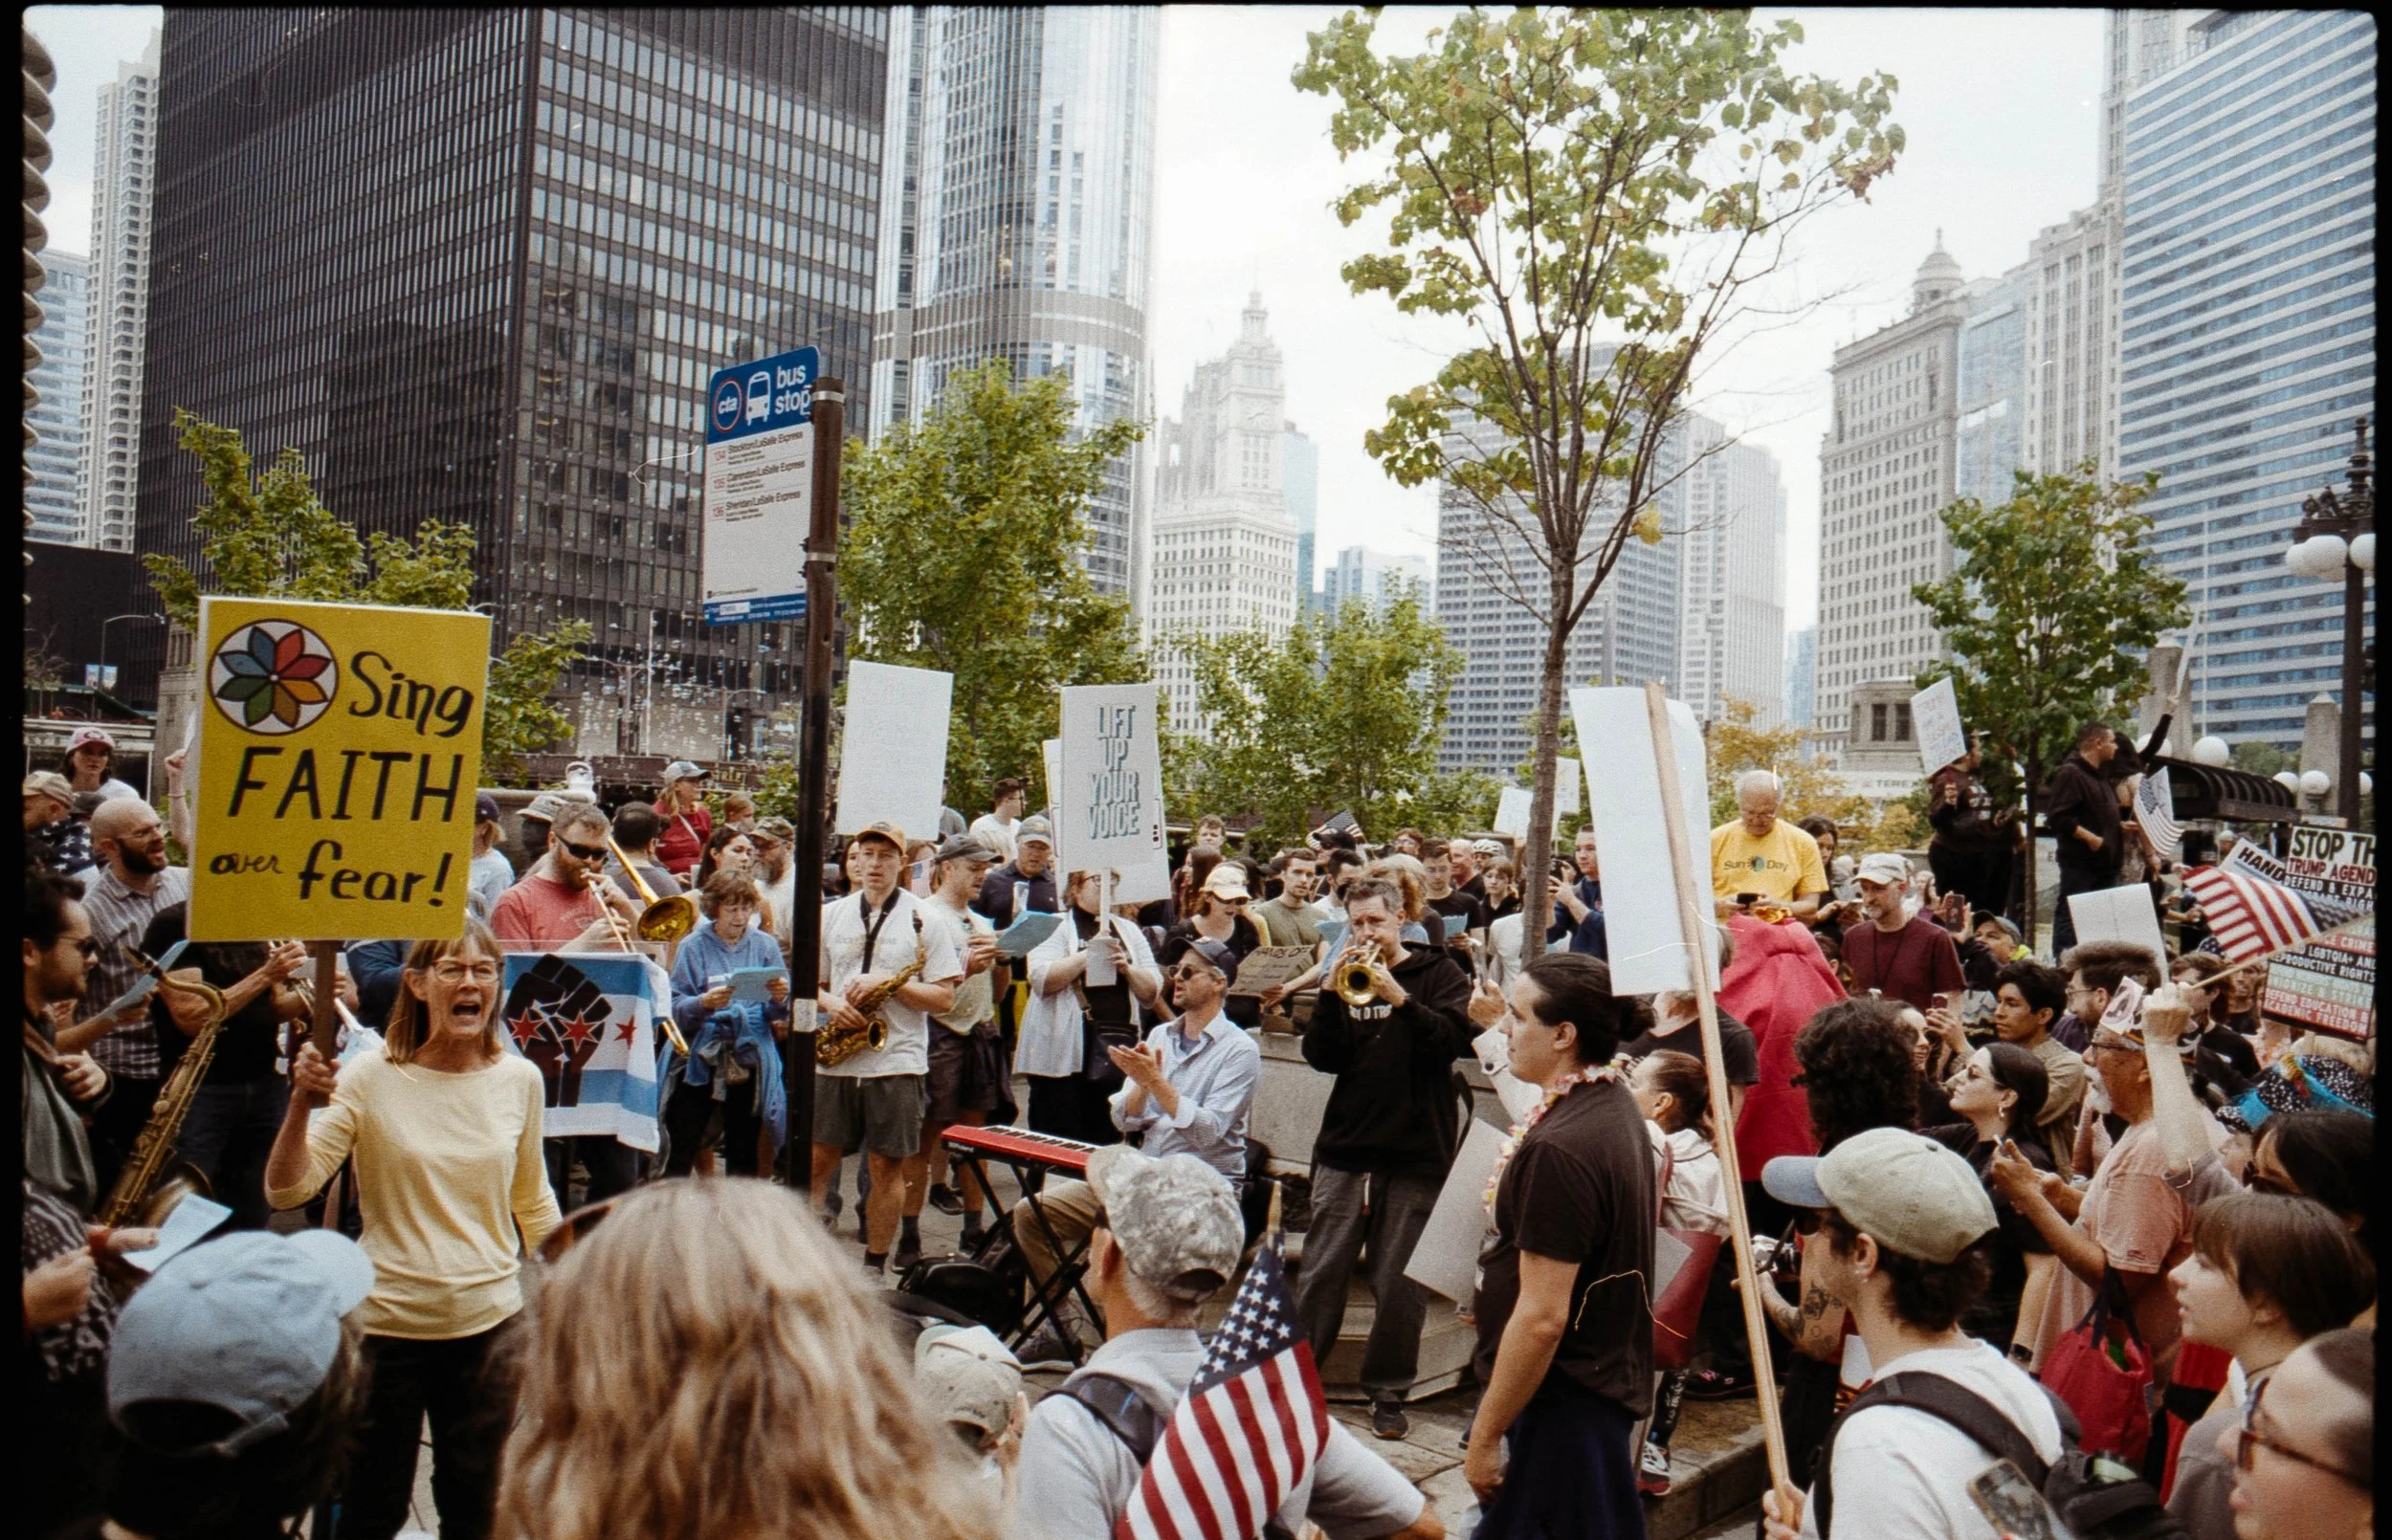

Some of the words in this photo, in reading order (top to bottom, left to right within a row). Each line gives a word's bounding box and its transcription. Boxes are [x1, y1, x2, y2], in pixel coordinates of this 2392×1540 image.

[776, 364, 807, 388] bus
[718, 396, 738, 414] cta
[774, 388, 811, 415] stop
[778, 431, 804, 444] Express
[780, 460, 806, 473] Express
[775, 491, 801, 502] Express
[347, 650, 475, 738] Sing
[1093, 703, 1137, 739] LIFT
[1099, 737, 1129, 771] UP
[228, 746, 464, 822] FAITH
[1089, 769, 1141, 806] YOUR
[1088, 802, 1141, 840] VOICE
[2292, 828, 2344, 861] STOP
[210, 852, 285, 875] over
[298, 839, 454, 908] fear!
[1723, 860, 1746, 870] Sun
[1766, 860, 1788, 872] Day
[2238, 847, 2286, 882] HAND
[2289, 857, 2327, 877] TRUMP
[2330, 864, 2377, 885] AGEND
[2285, 876, 2323, 891] DEFEND
[2341, 884, 2374, 899] EXPA
[2272, 953, 2337, 975] EPRODUCTIVE
[2338, 965, 2376, 982] RIGHTS
